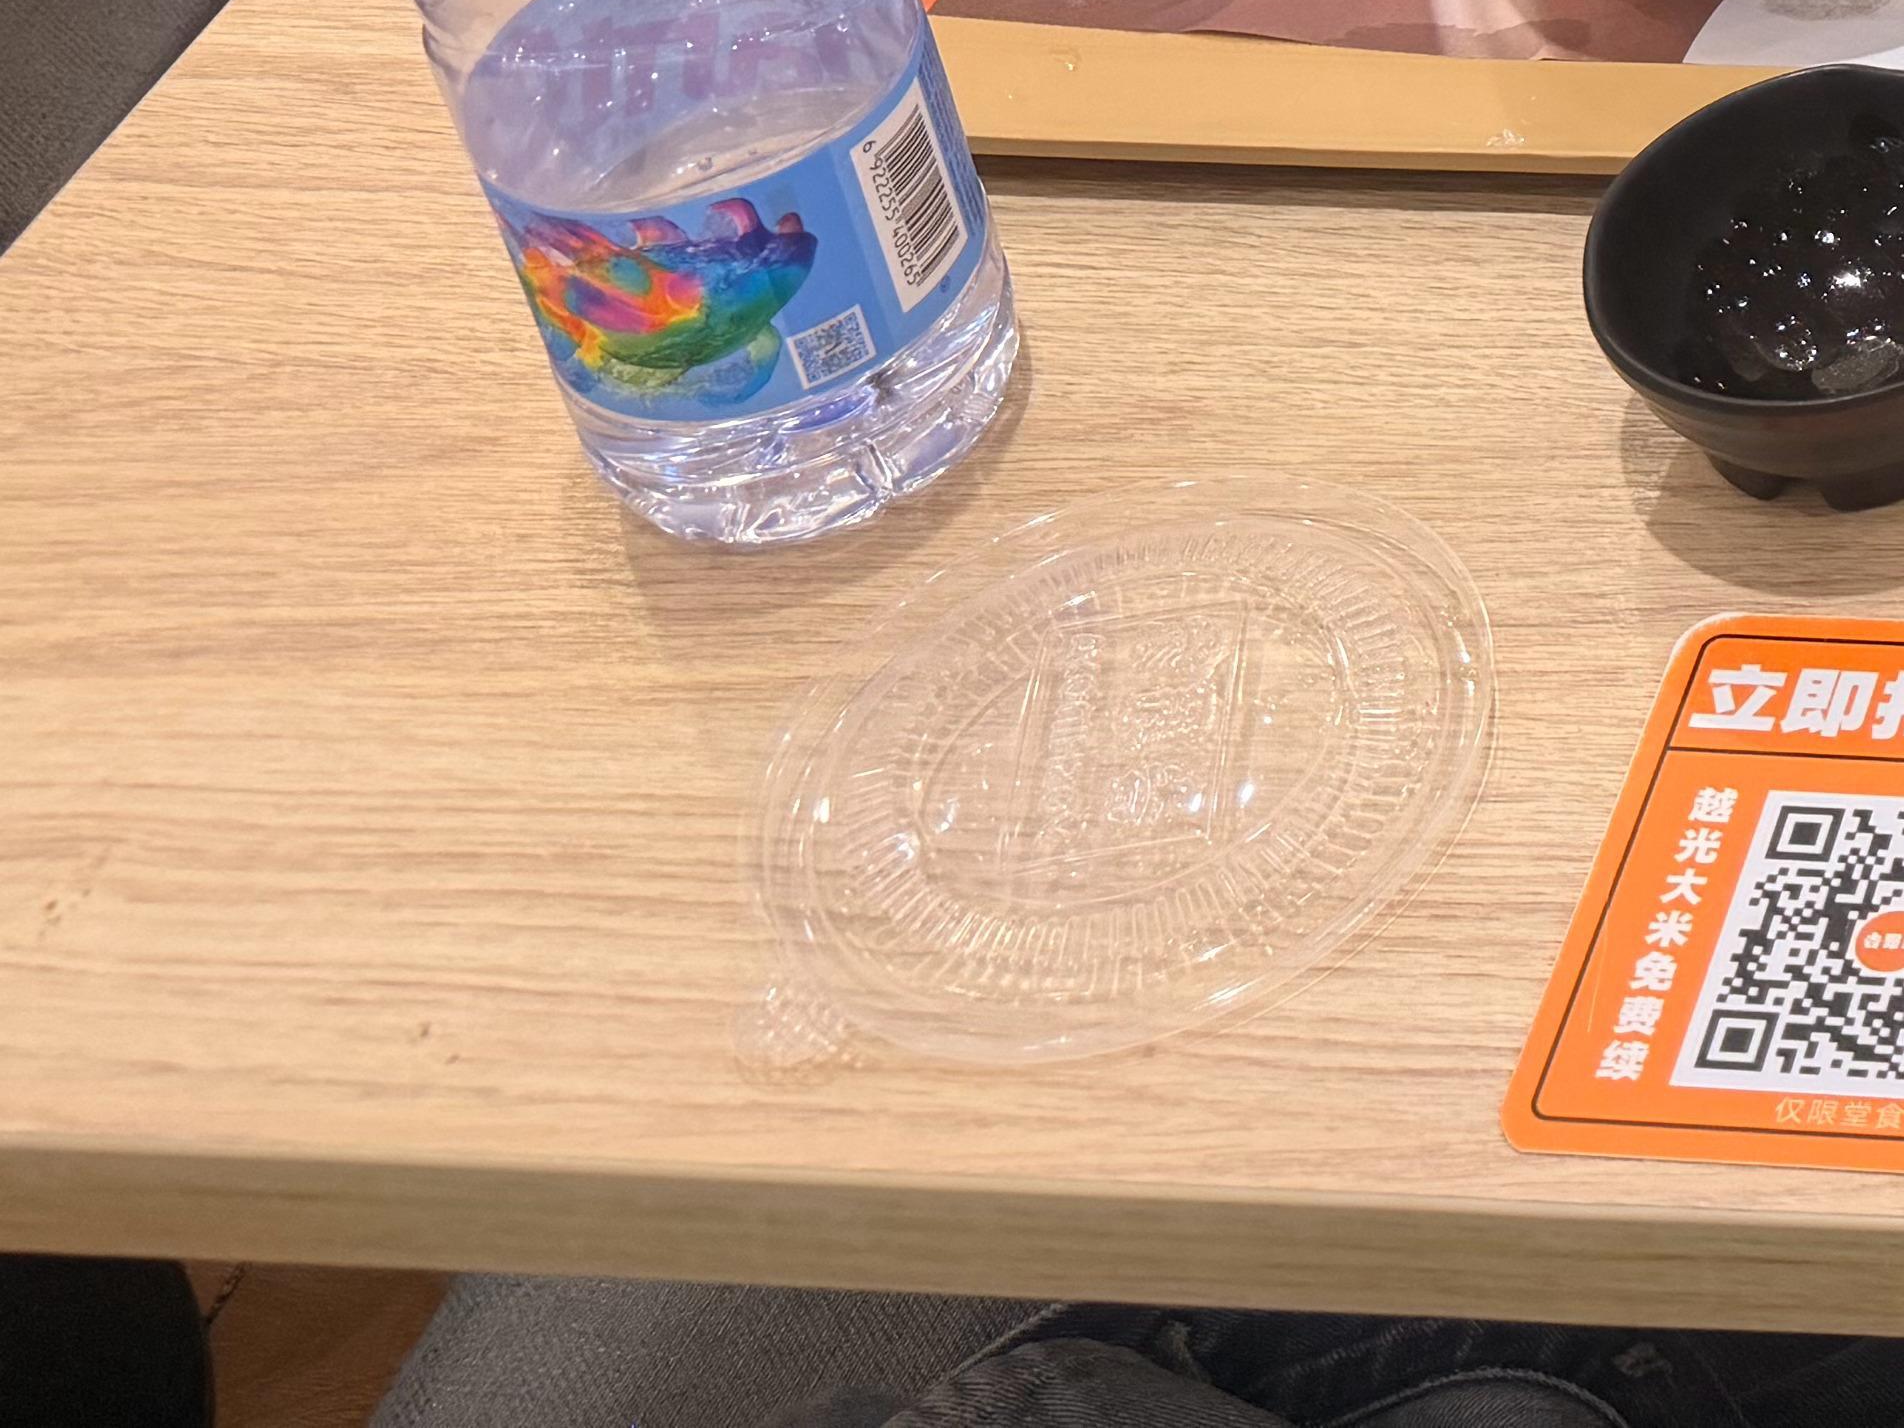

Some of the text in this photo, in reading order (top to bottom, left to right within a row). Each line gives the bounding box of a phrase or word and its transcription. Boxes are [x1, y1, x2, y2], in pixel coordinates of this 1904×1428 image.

[862, 140, 921, 286] 6 922255 400265
[1596, 786, 1739, 1081] 越光大米免费续
